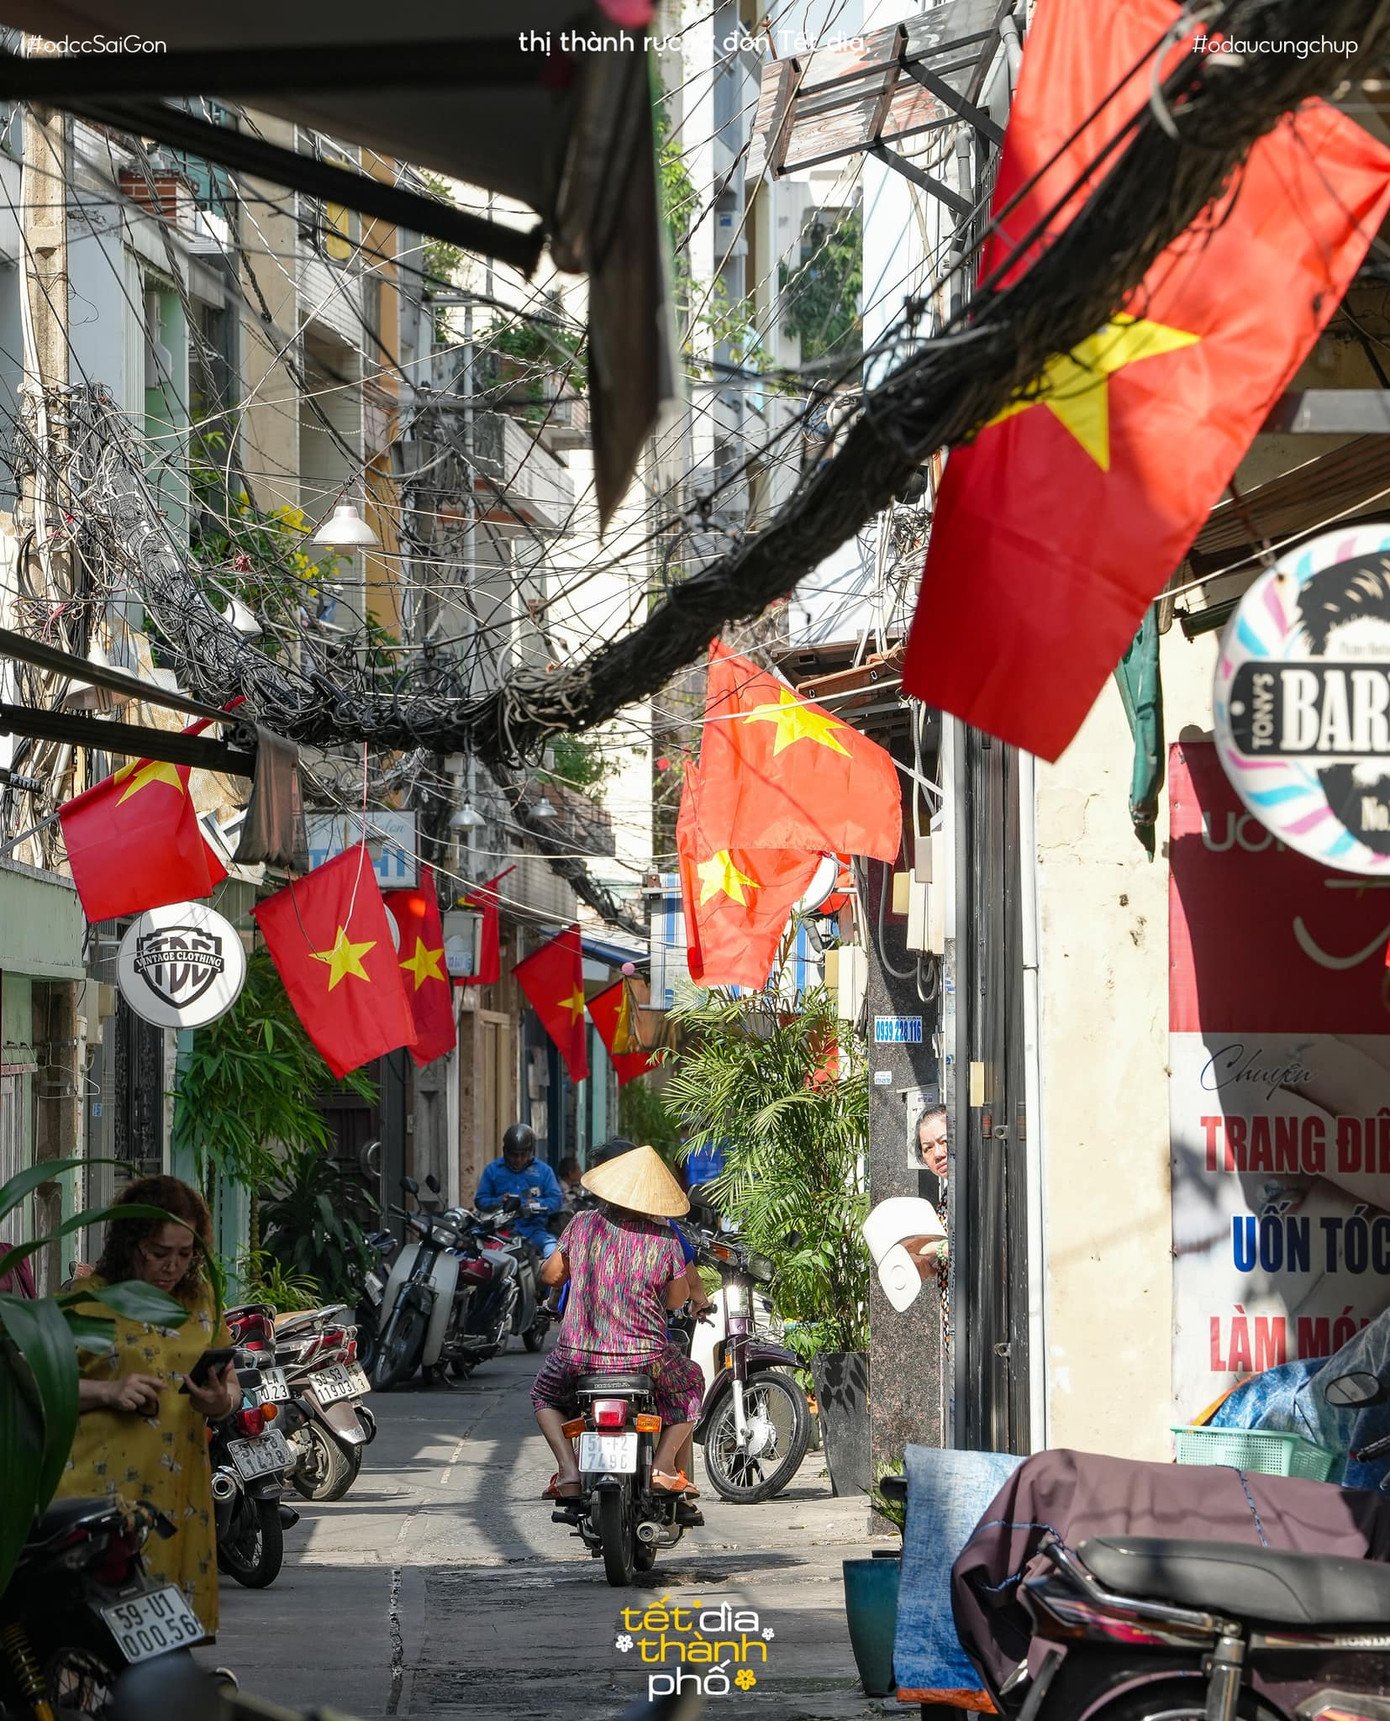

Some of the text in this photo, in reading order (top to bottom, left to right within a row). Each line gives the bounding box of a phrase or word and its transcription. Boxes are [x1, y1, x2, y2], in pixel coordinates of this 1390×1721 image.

[1279, 669, 1390, 751] BAR
[135, 951, 222, 968] VINTAGE CLOTHING
[876, 1020, 922, 1041] 0939.228.116
[1200, 1115, 1326, 1173] TRANG
[1232, 1202, 1311, 1273] UỐN
[1209, 1304, 1375, 1373] LÀM MÓ
[317, 1378, 353, 1402] 119.03
[114, 1592, 176, 1630] 59-U1
[122, 1613, 198, 1657] 000.56
